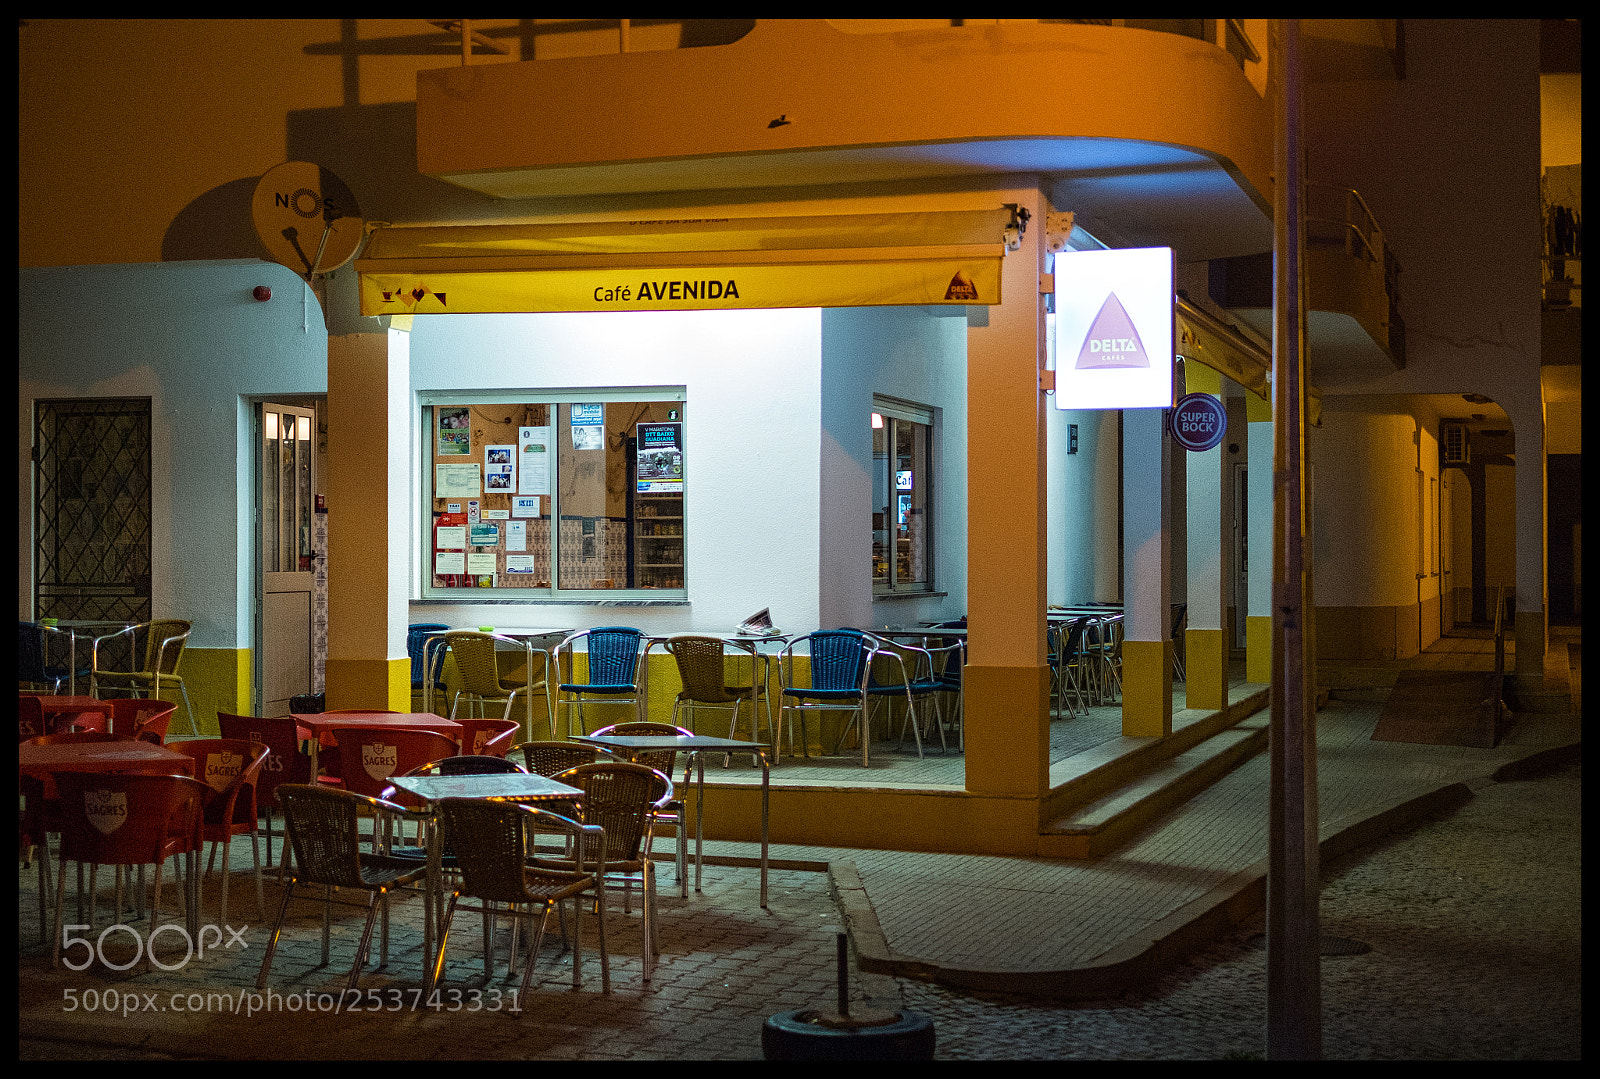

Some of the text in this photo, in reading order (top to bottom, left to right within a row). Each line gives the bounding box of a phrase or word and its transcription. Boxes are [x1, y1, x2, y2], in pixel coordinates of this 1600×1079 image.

[275, 187, 334, 218] NOS
[594, 280, 740, 302] Café AVENIDA
[951, 285, 974, 293] DELTA
[1090, 338, 1137, 352] DELTA
[1180, 412, 1216, 422] SUPER
[1182, 422, 1214, 432] BOCK
[364, 756, 396, 766] SAGRES
[206, 764, 242, 777] SAGRES
[87, 803, 126, 817] SAGRES
